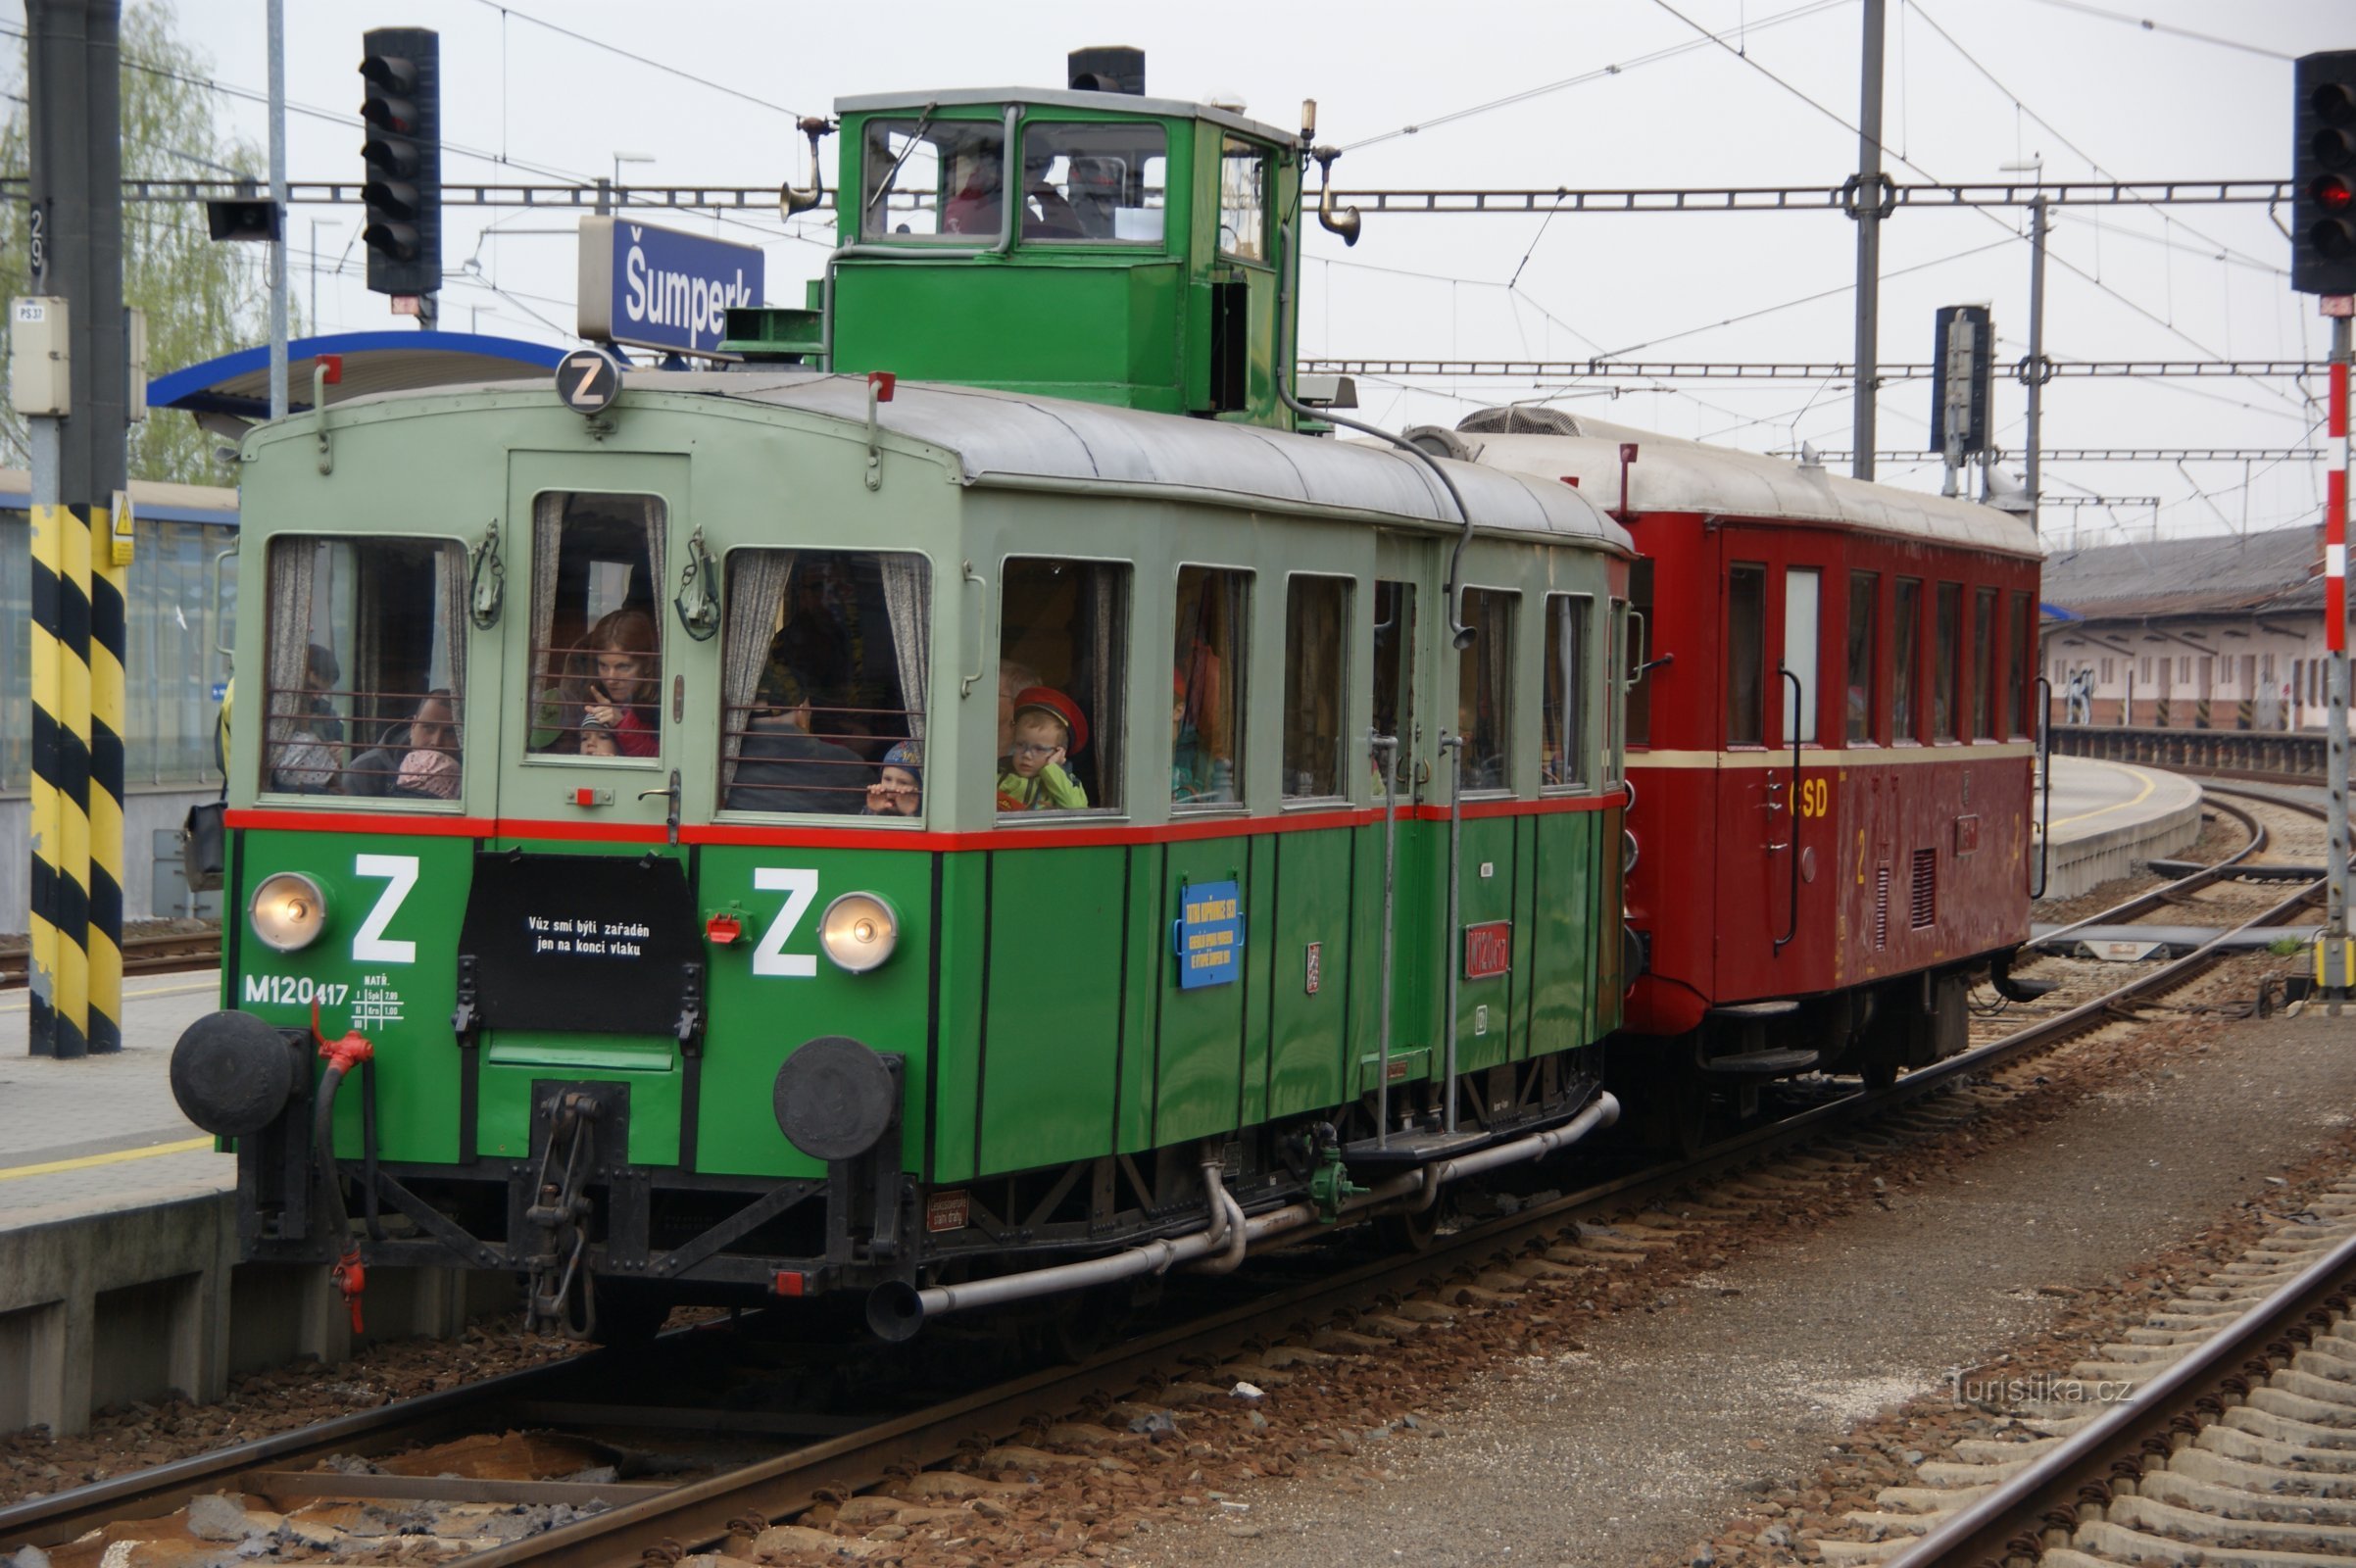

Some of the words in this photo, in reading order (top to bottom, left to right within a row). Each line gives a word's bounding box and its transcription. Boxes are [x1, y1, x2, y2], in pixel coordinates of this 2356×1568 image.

[570, 358, 604, 405] Z
[1857, 829, 1866, 884] 2
[353, 854, 419, 963] Z
[554, 919, 573, 933] smí
[576, 919, 597, 937] býti
[605, 922, 650, 938] zařaděn
[753, 867, 818, 976] Z
[536, 936, 554, 953] jen
[558, 940, 570, 952] na
[575, 938, 606, 954] konci
[611, 942, 641, 956] vlaku
